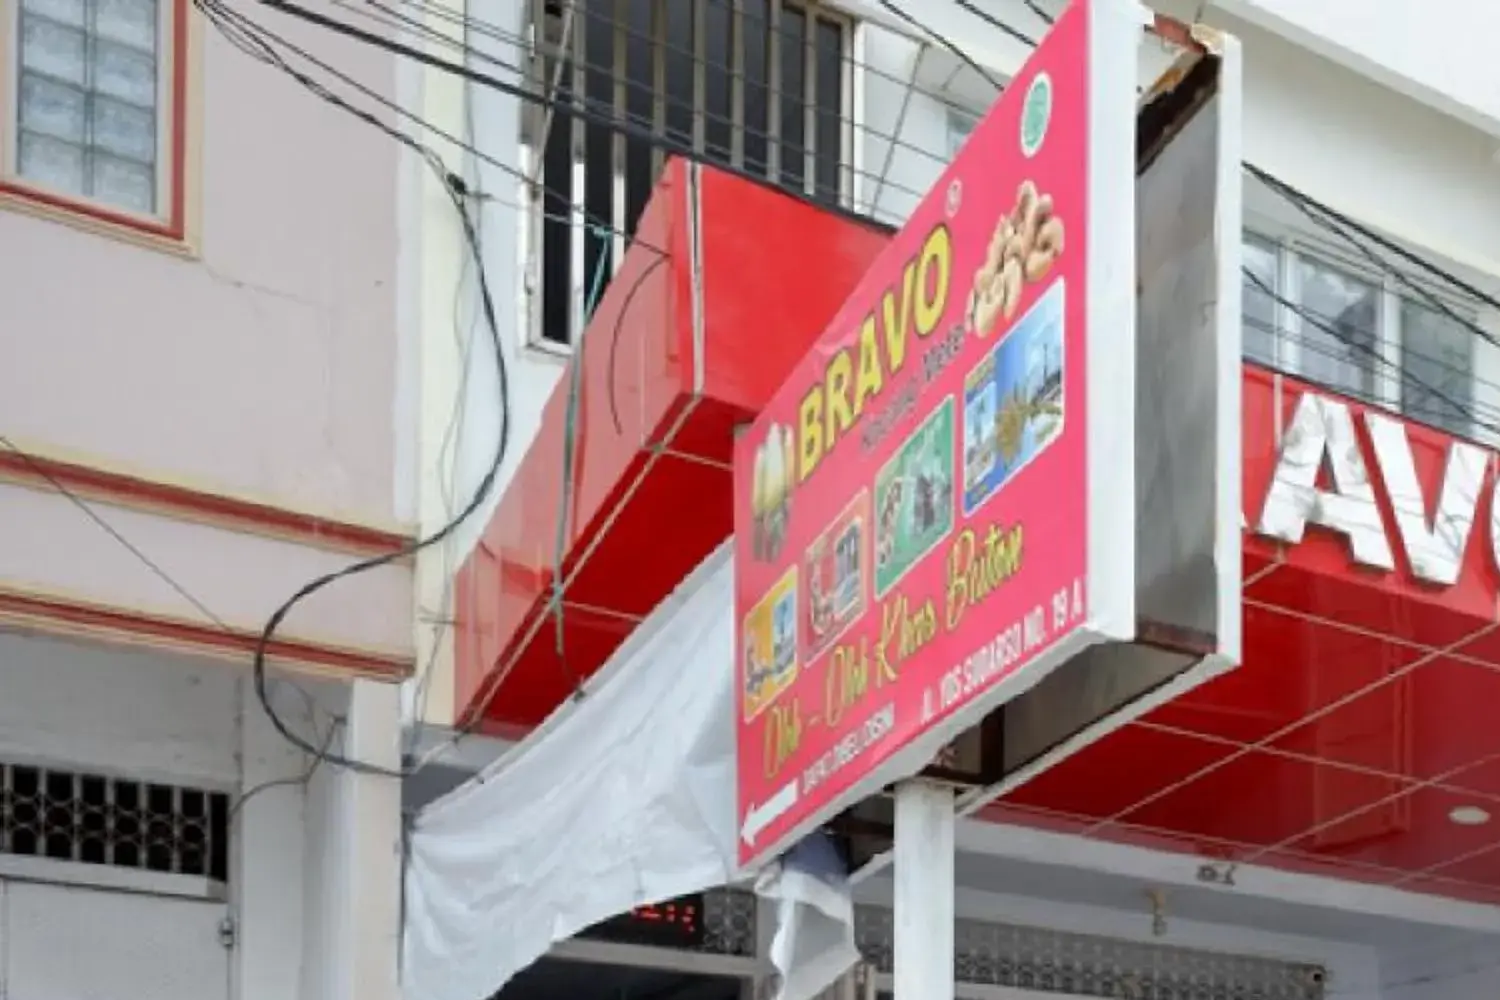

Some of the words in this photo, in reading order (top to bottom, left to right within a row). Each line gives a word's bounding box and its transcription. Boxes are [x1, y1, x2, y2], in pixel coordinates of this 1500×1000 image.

[800, 223, 953, 482] BRAVO
[875, 594, 937, 688] Khas
[945, 523, 1022, 631] Buton
